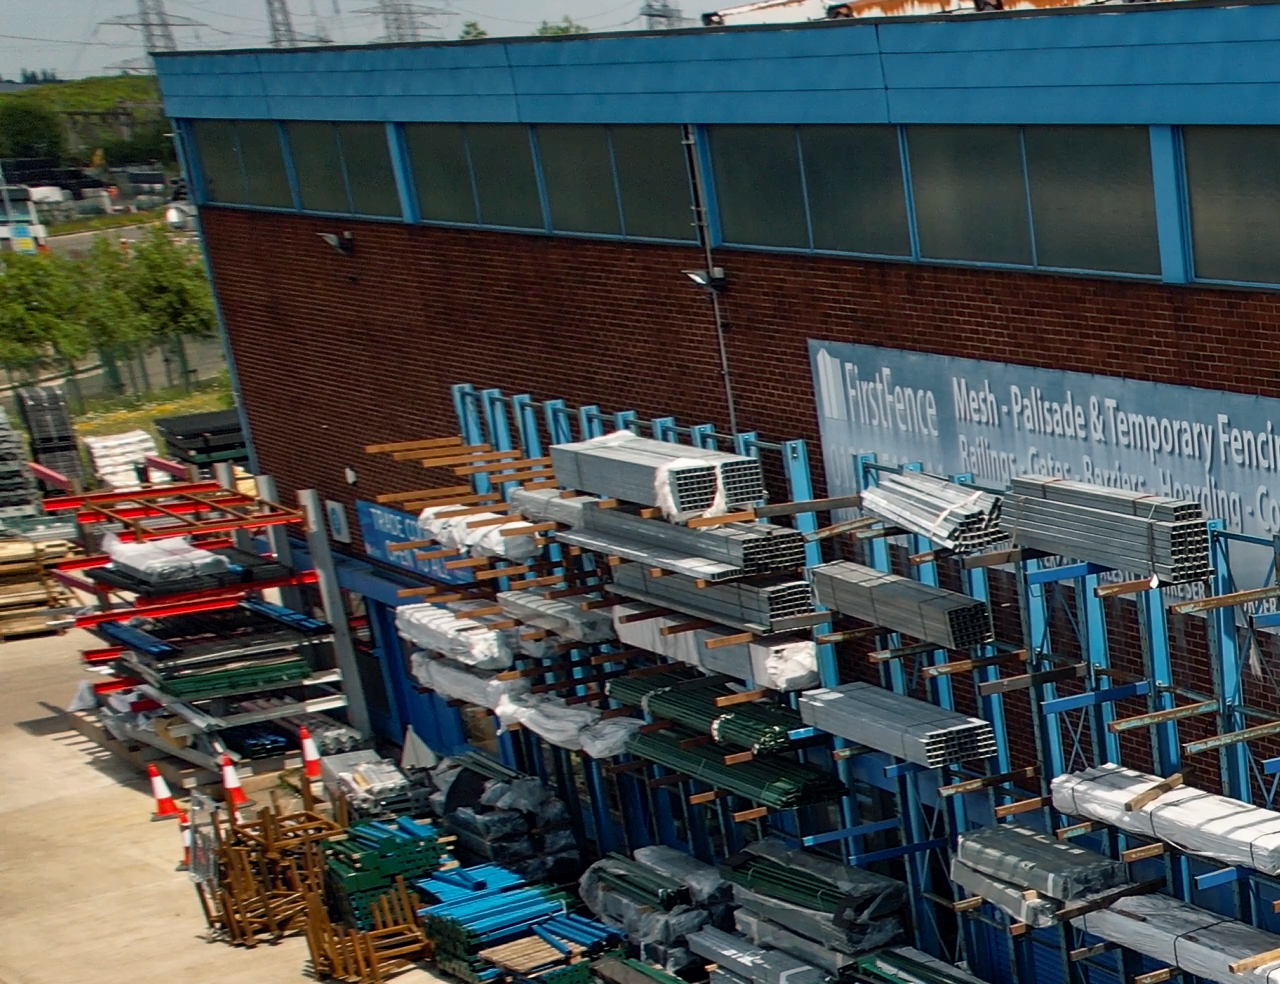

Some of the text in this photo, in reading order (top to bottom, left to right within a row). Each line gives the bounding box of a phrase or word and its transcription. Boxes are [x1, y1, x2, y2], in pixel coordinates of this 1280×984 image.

[844, 362, 939, 436] FirstFence
[952, 377, 999, 427] Mesh
[1010, 385, 1087, 439] Palisade
[1089, 395, 1106, 443] &
[1104, 398, 1213, 471] Temporary
[958, 435, 1016, 491] Railings
